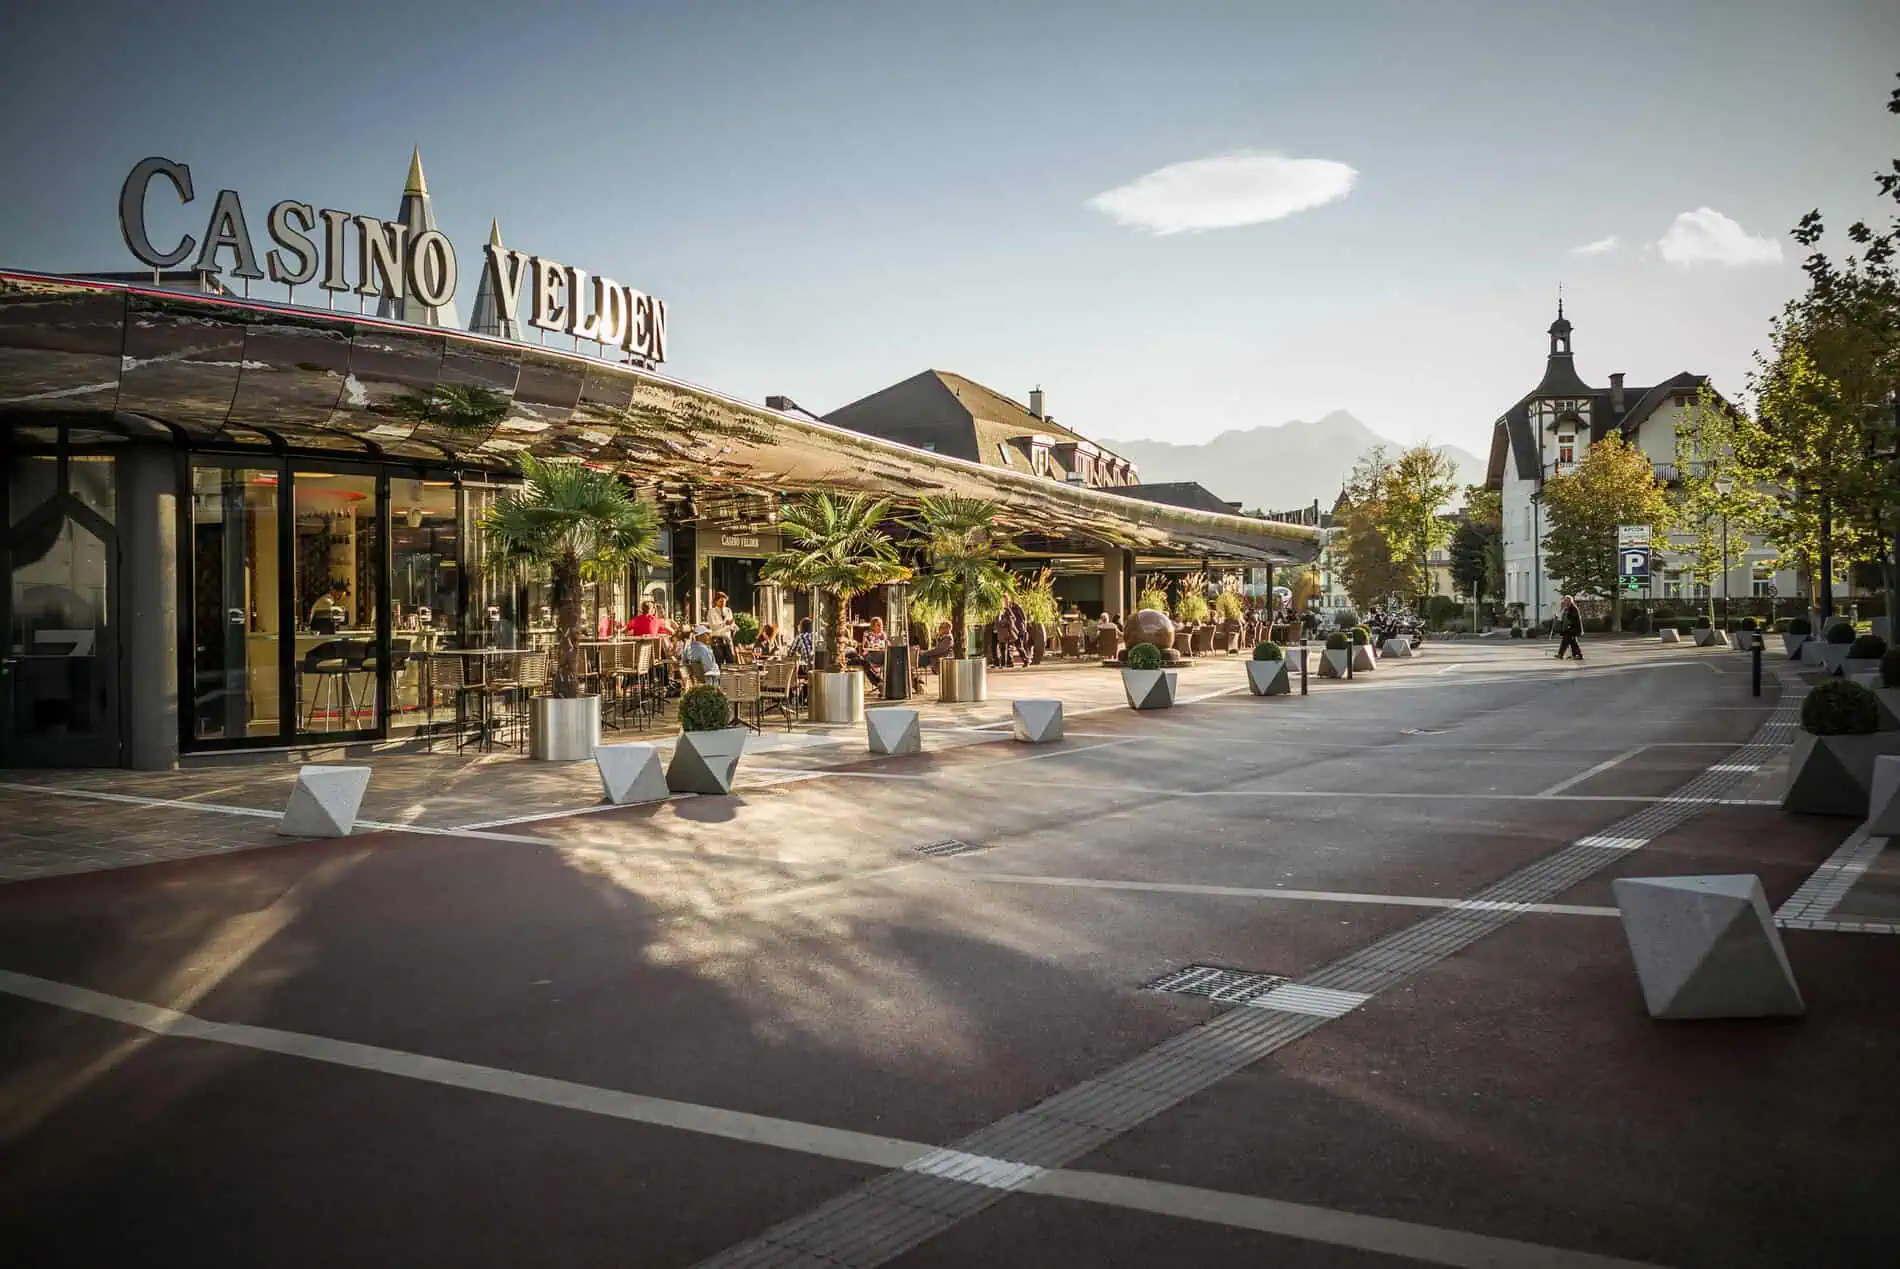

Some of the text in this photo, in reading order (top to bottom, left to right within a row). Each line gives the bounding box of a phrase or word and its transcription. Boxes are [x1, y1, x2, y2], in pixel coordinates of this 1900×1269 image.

[118, 156, 668, 363] CASINO VELDEN
[1625, 554, 1644, 574] P
